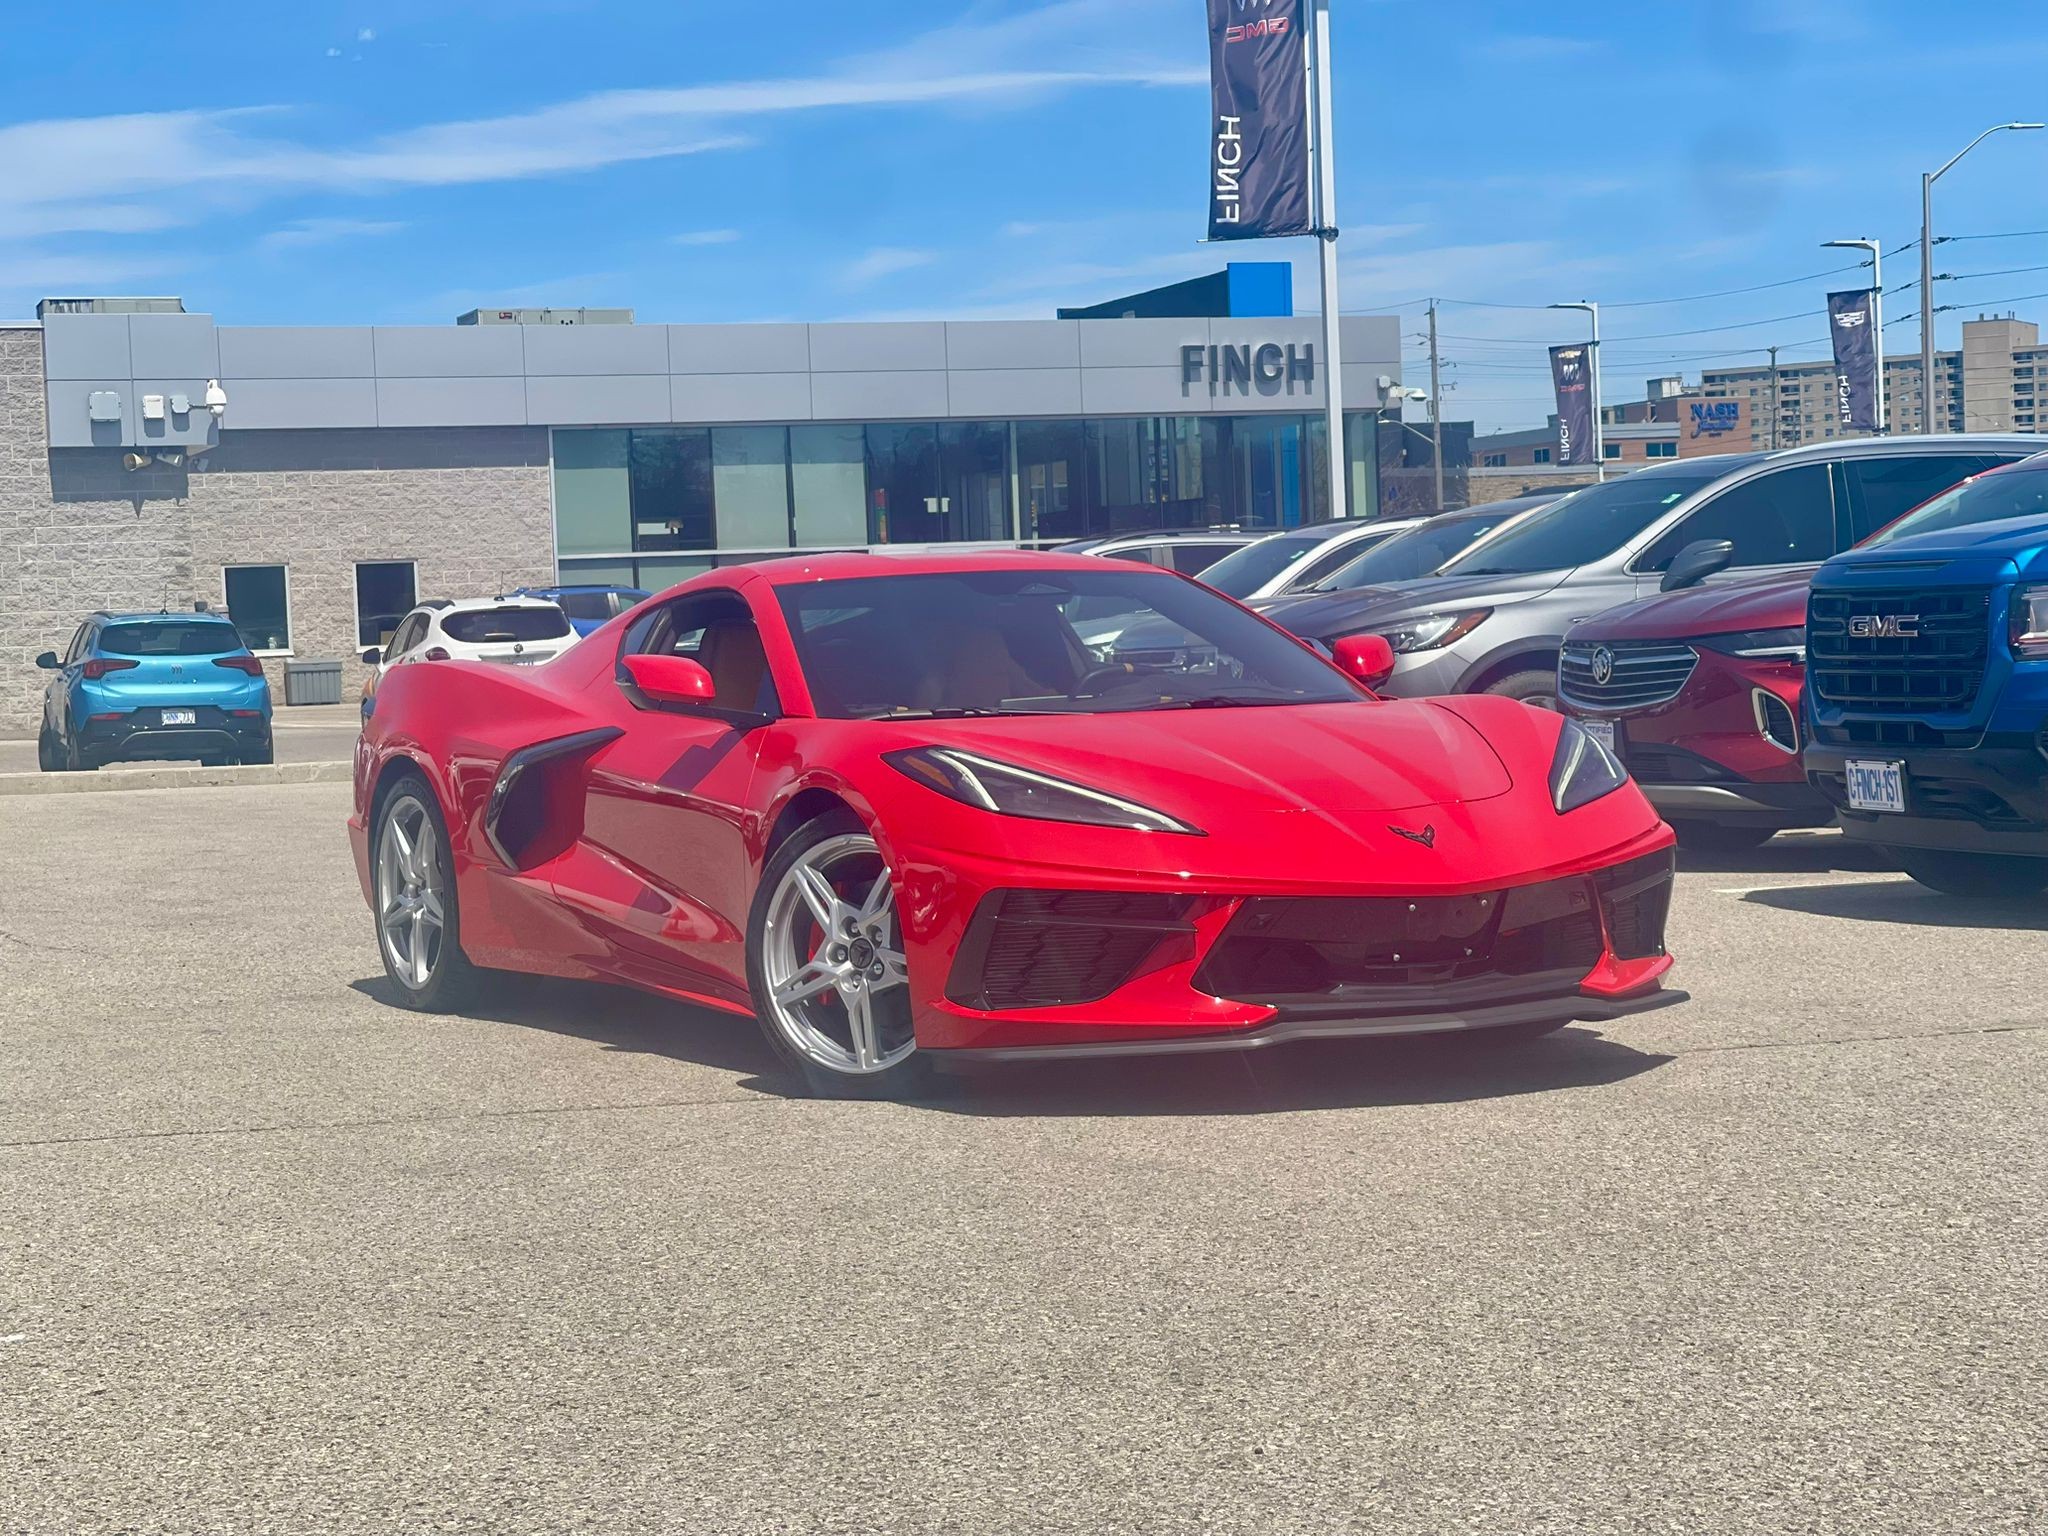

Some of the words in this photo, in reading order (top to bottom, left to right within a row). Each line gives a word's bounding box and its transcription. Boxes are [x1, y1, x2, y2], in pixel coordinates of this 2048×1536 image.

[1180, 343, 1315, 383] FINCH
[1690, 402, 1739, 421] NASH
[1848, 614, 1920, 637] GMC
[1586, 726, 1613, 735] TIFIED
